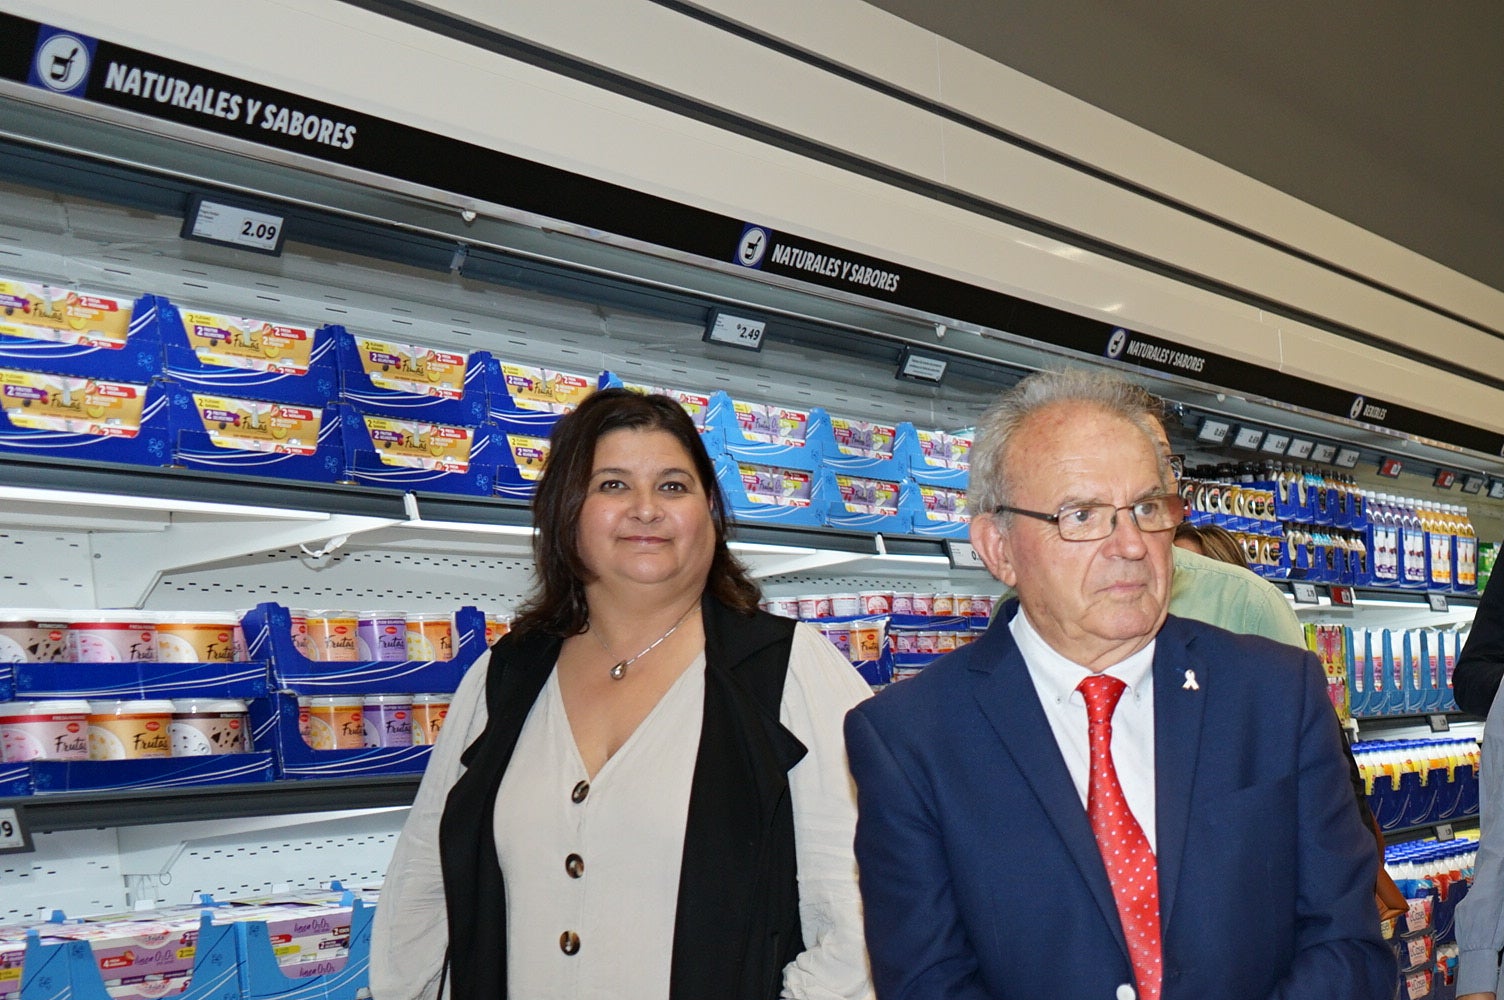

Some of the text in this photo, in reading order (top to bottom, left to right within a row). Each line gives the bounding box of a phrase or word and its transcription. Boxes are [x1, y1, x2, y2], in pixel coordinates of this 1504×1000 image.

[104, 62, 358, 150] NATURALES Y SABORES
[241, 221, 277, 240] 2.09
[771, 243, 900, 292] NATURALES Y SABORES
[739, 325, 761, 341] 2.49
[1126, 340, 1168, 363] NATURALES
[1174, 353, 1205, 372] SABORES
